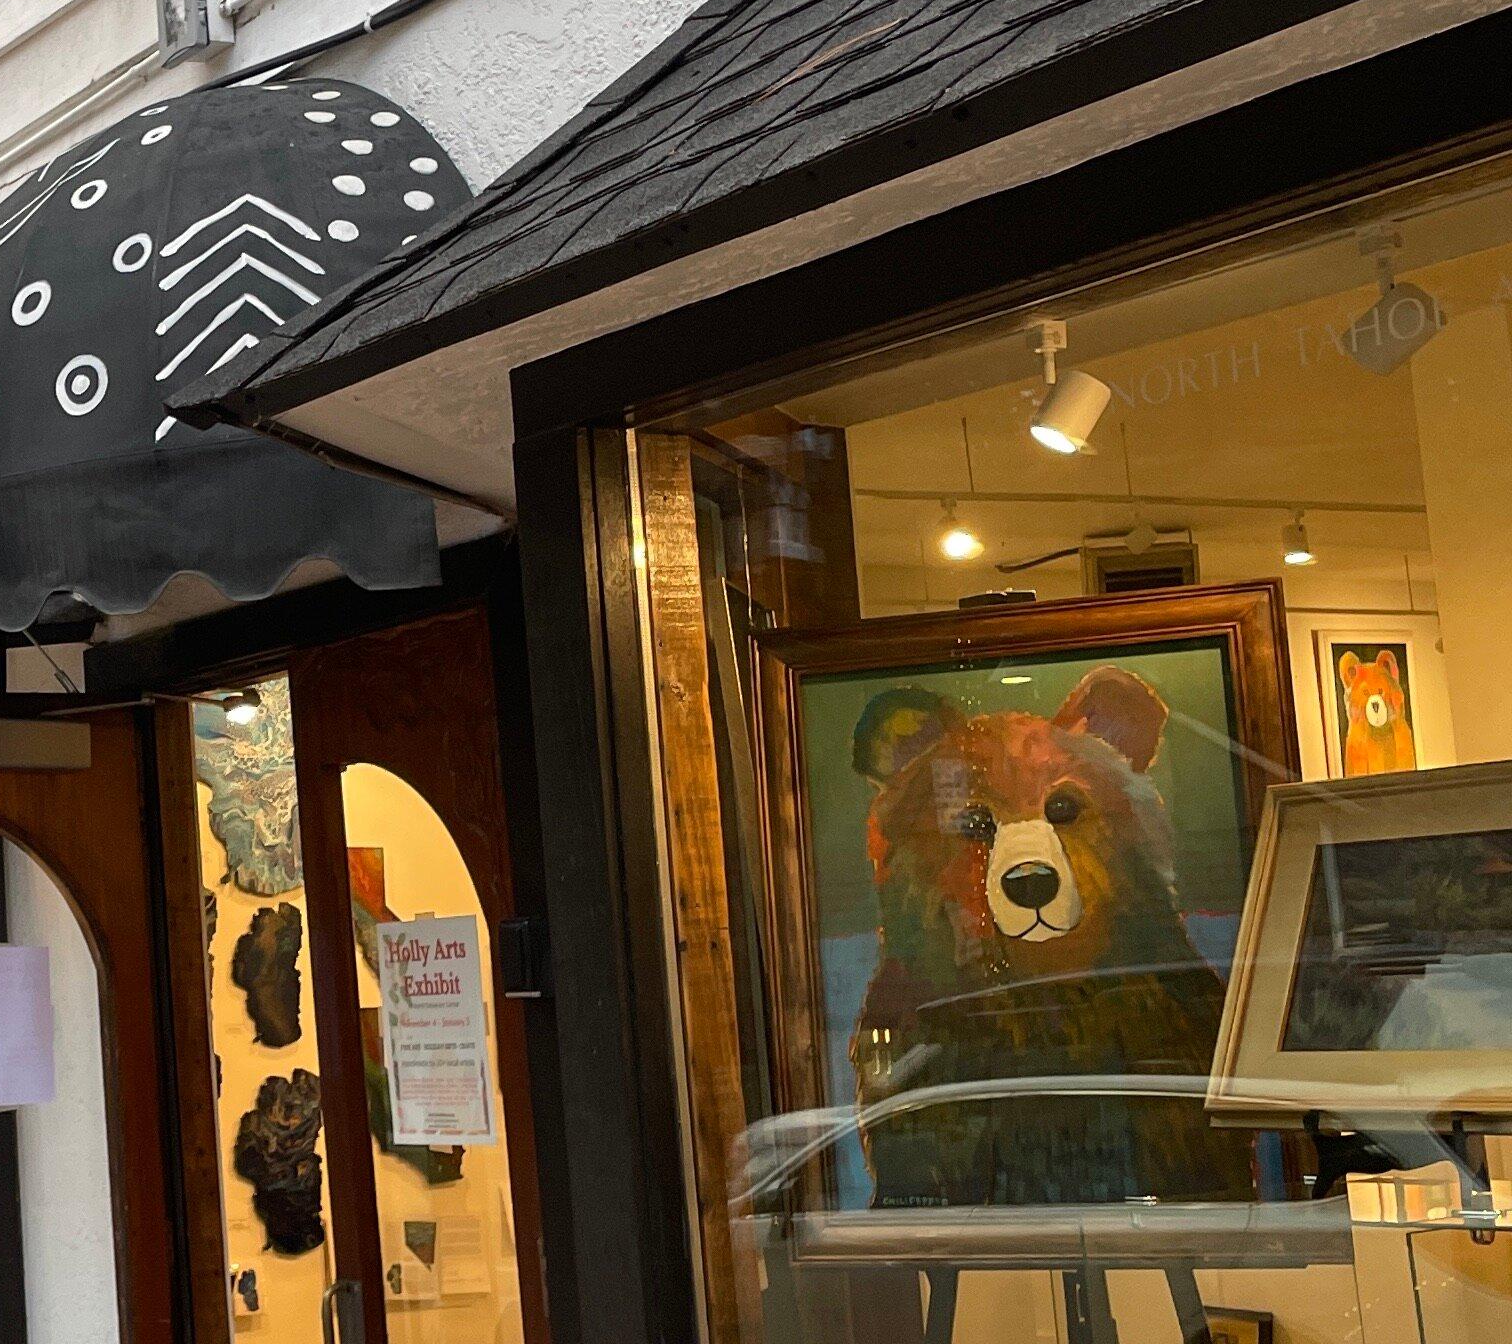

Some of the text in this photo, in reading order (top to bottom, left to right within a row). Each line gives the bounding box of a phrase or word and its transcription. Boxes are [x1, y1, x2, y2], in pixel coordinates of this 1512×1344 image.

[1109, 342, 1261, 411] NORTH
[388, 938, 466, 967] Holly Arts
[403, 971, 462, 998] Exhibit
